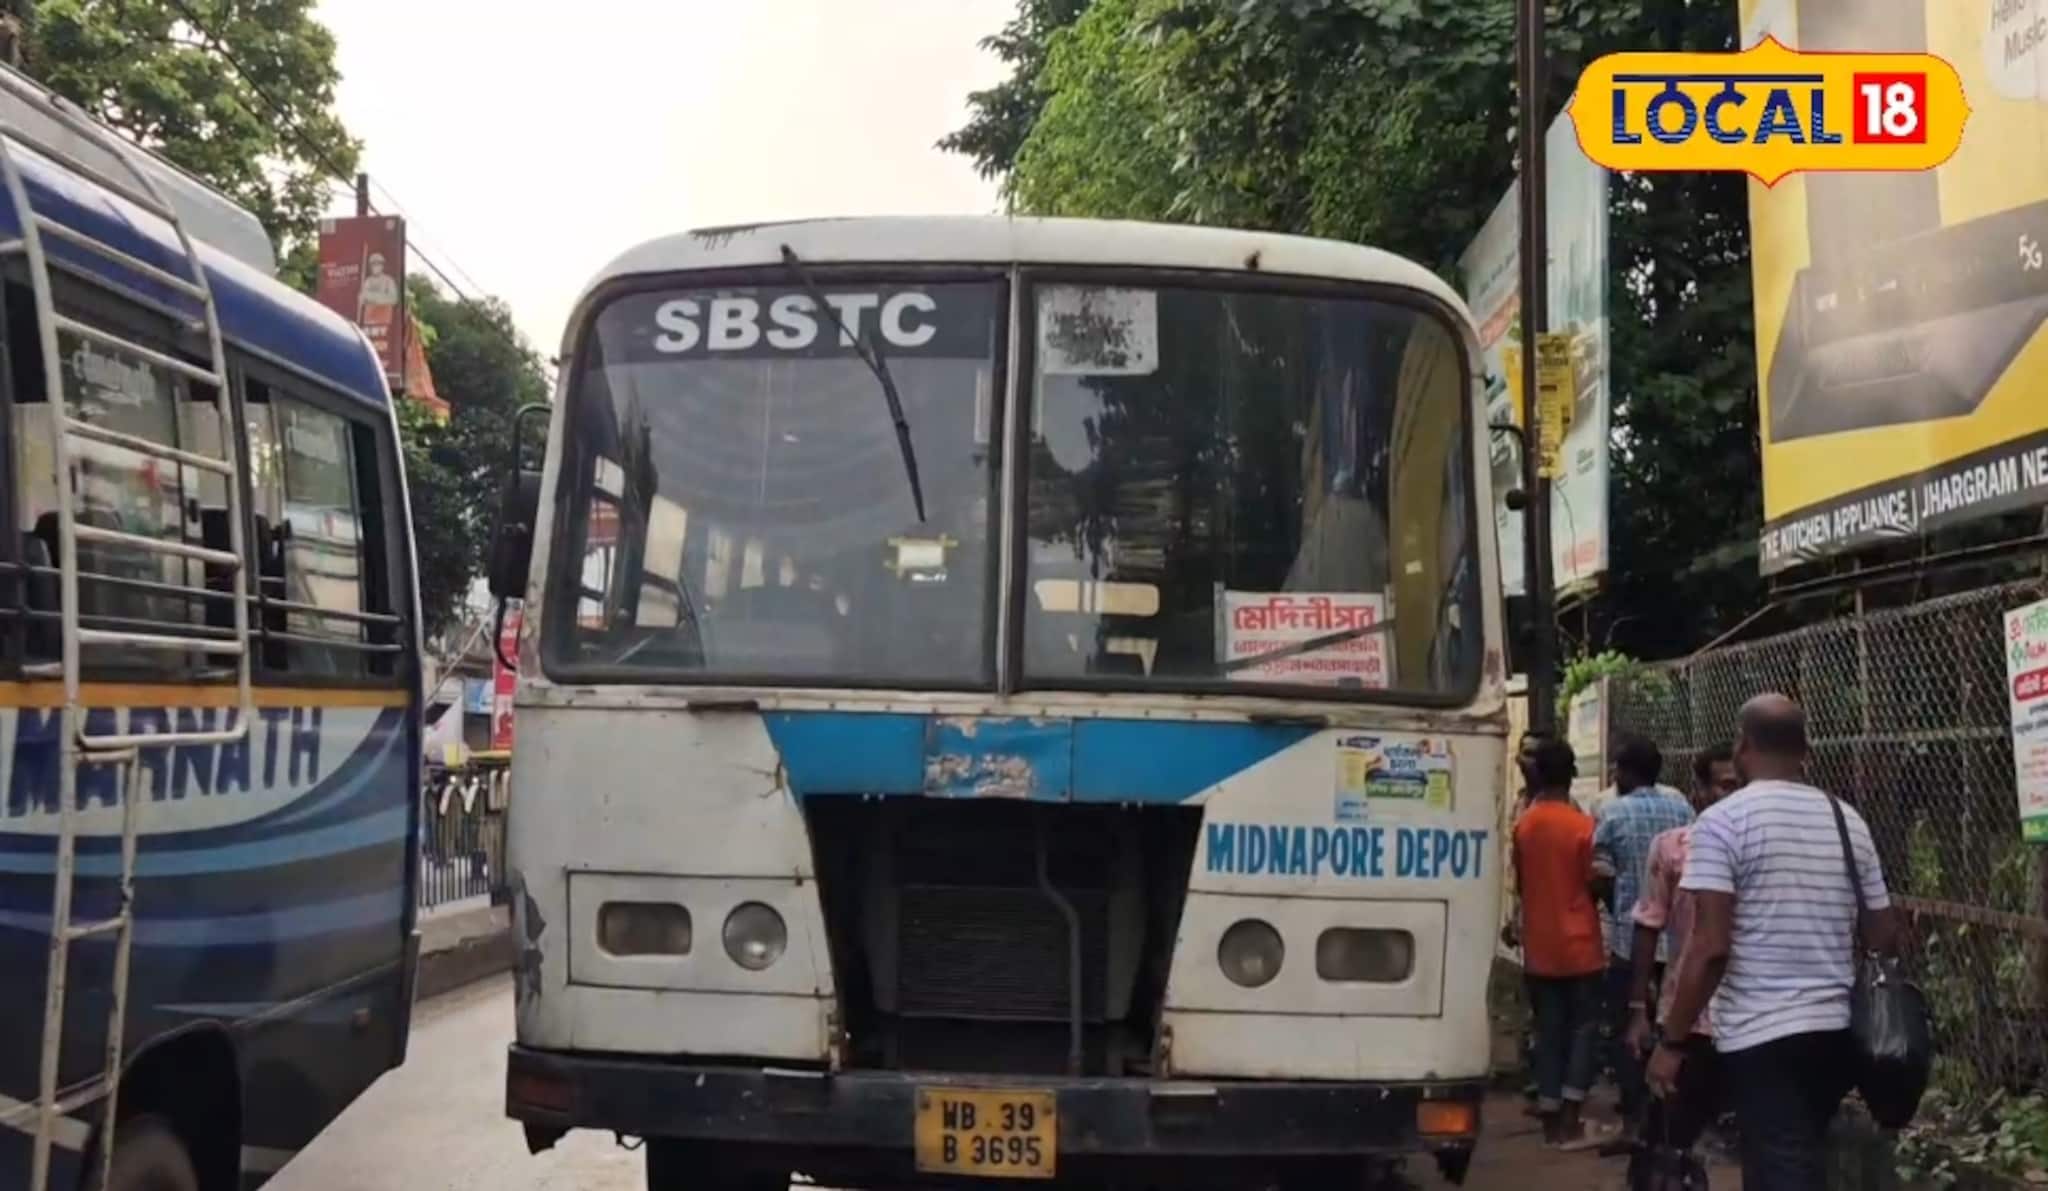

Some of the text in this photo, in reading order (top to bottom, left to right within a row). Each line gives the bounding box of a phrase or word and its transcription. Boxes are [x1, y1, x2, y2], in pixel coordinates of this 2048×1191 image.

[654, 292, 937, 353] SBSTC
[1779, 510, 1832, 555] KITCHEN
[1832, 490, 1908, 539] APPLIANCE
[1922, 456, 2018, 518] JHARGRAM
[1207, 823, 1488, 878] MIDNAPORE DEPOT
[942, 1100, 1035, 1131] WB 39
[943, 1134, 1042, 1167] B 3695
